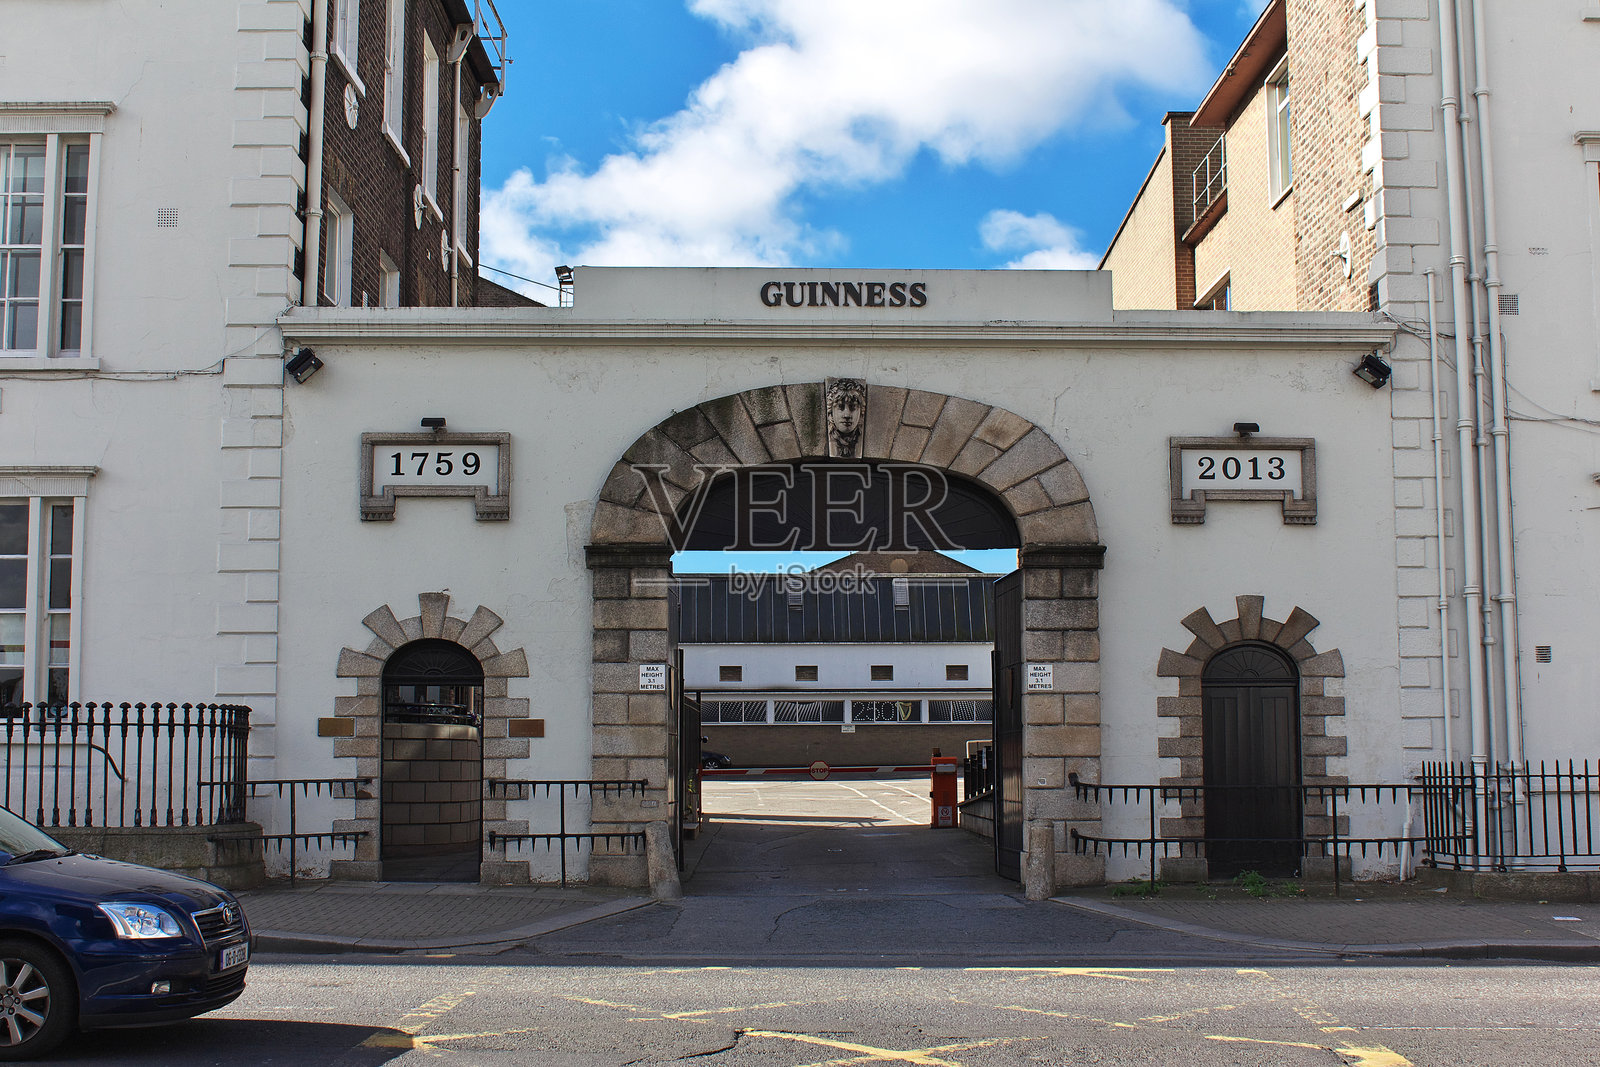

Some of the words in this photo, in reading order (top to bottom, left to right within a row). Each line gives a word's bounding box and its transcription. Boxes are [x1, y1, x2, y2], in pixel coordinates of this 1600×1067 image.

[760, 281, 928, 307] GUINNESS
[390, 452, 481, 476] 1759
[1197, 456, 1286, 480] 2013
[852, 701, 894, 721] 250
